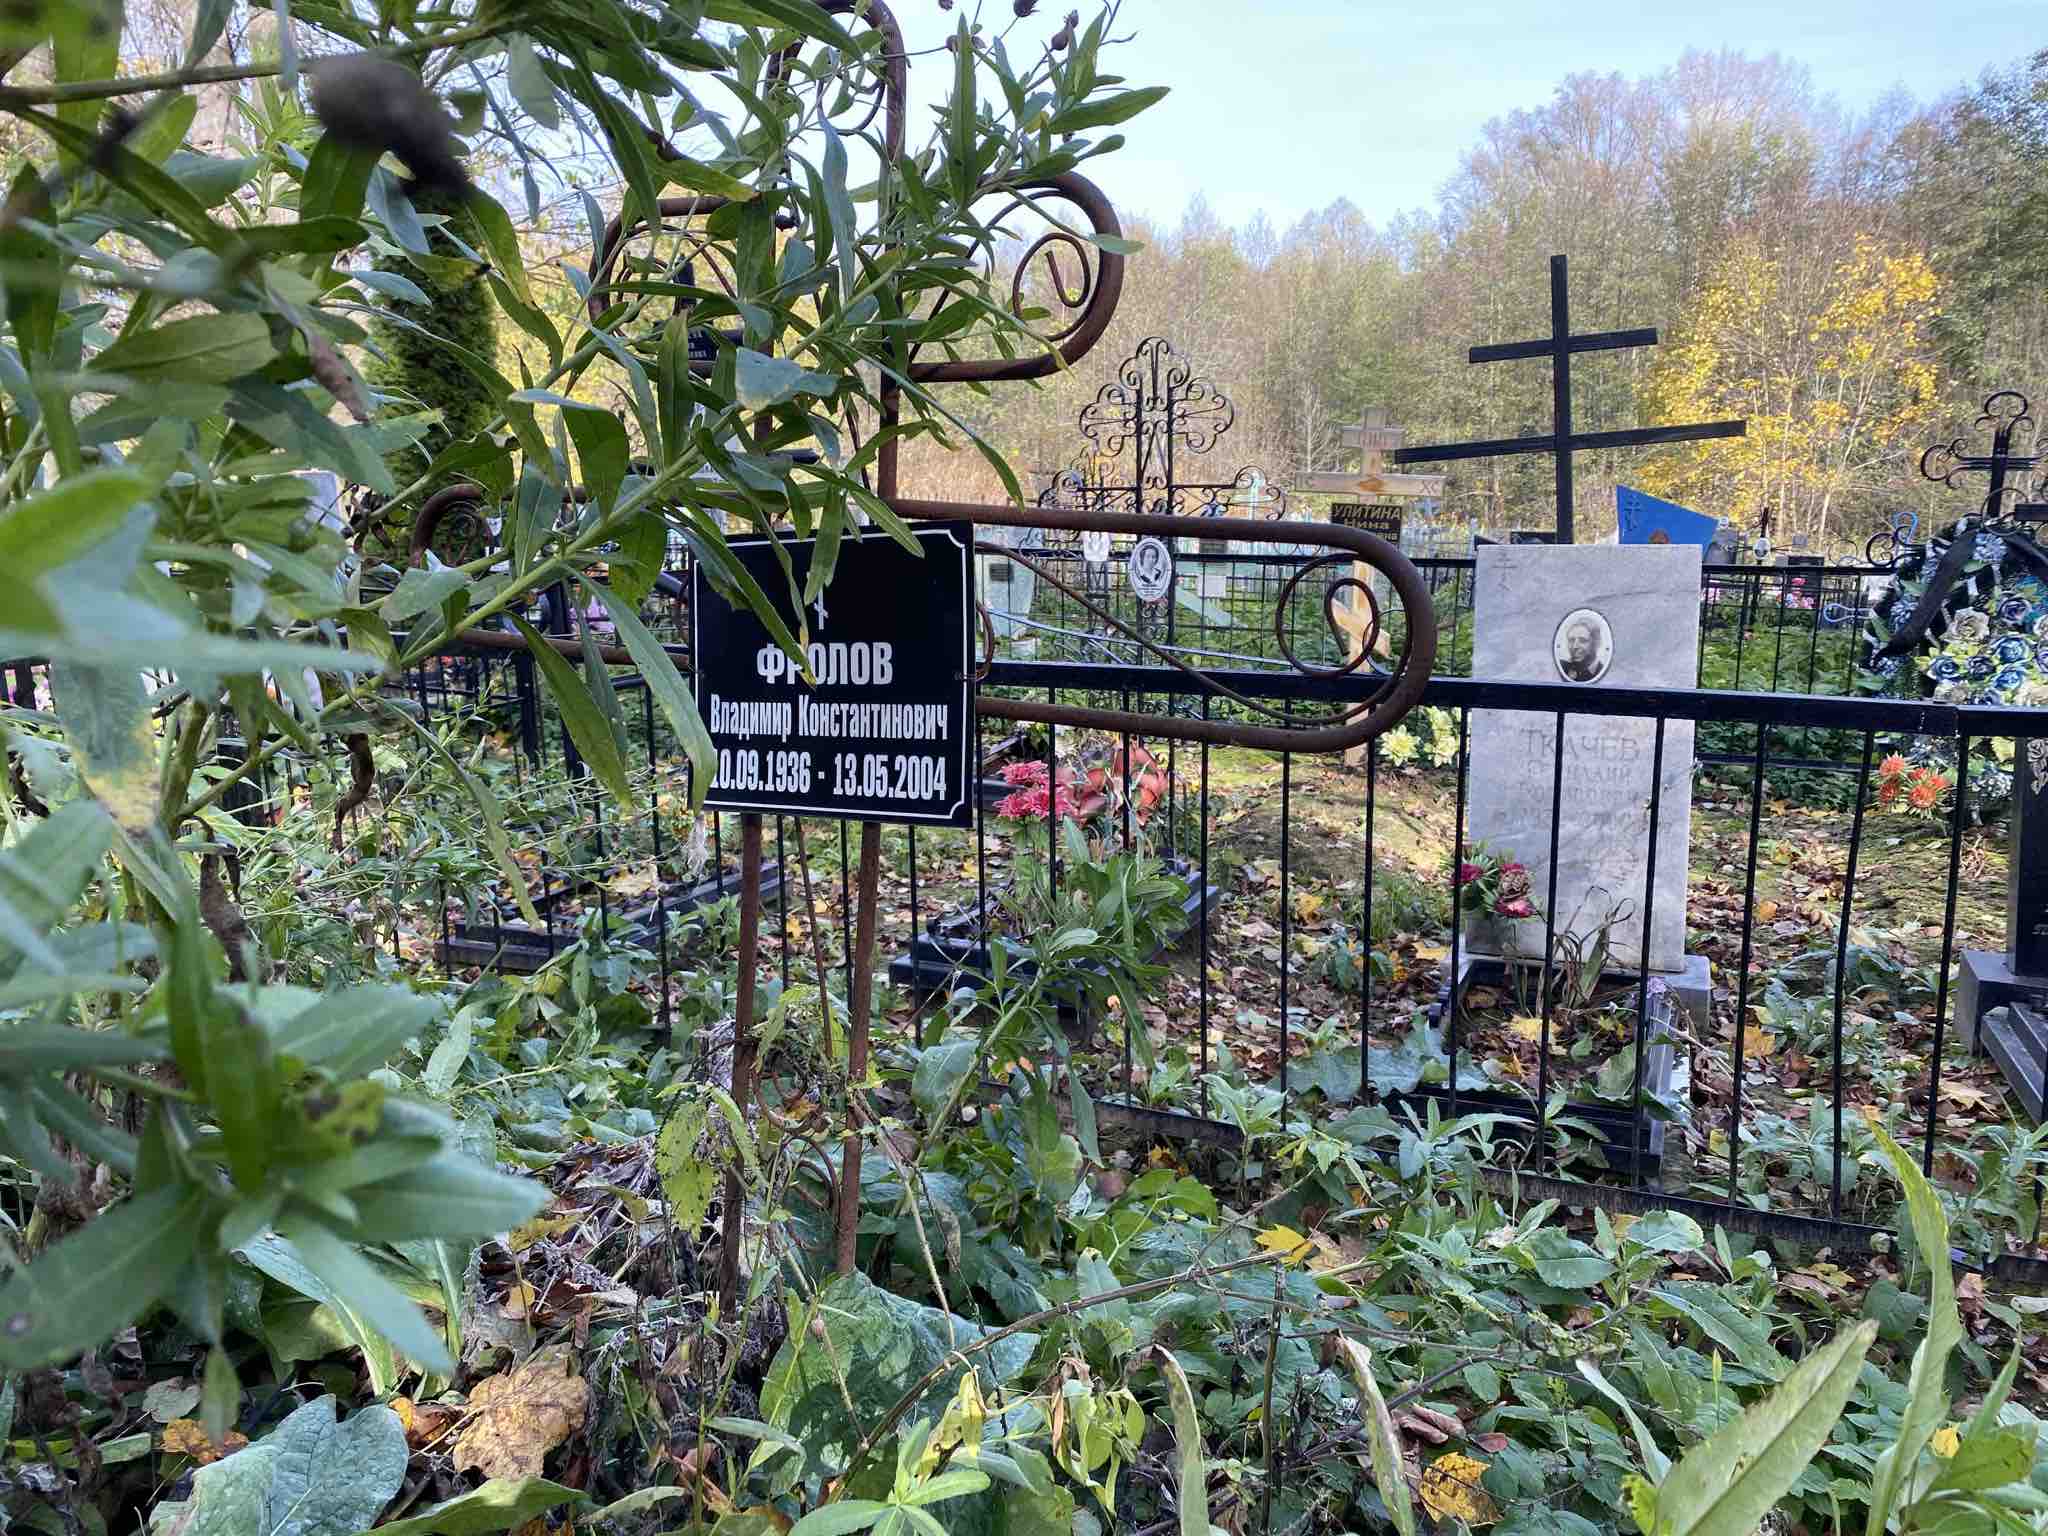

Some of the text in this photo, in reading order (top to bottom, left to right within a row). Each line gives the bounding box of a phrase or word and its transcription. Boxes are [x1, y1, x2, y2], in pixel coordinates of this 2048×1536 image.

[1335, 504, 1400, 520] УЛИТИНА
[710, 694, 948, 742] Владимир Константинович
[833, 753, 947, 800] 13.05.2004
